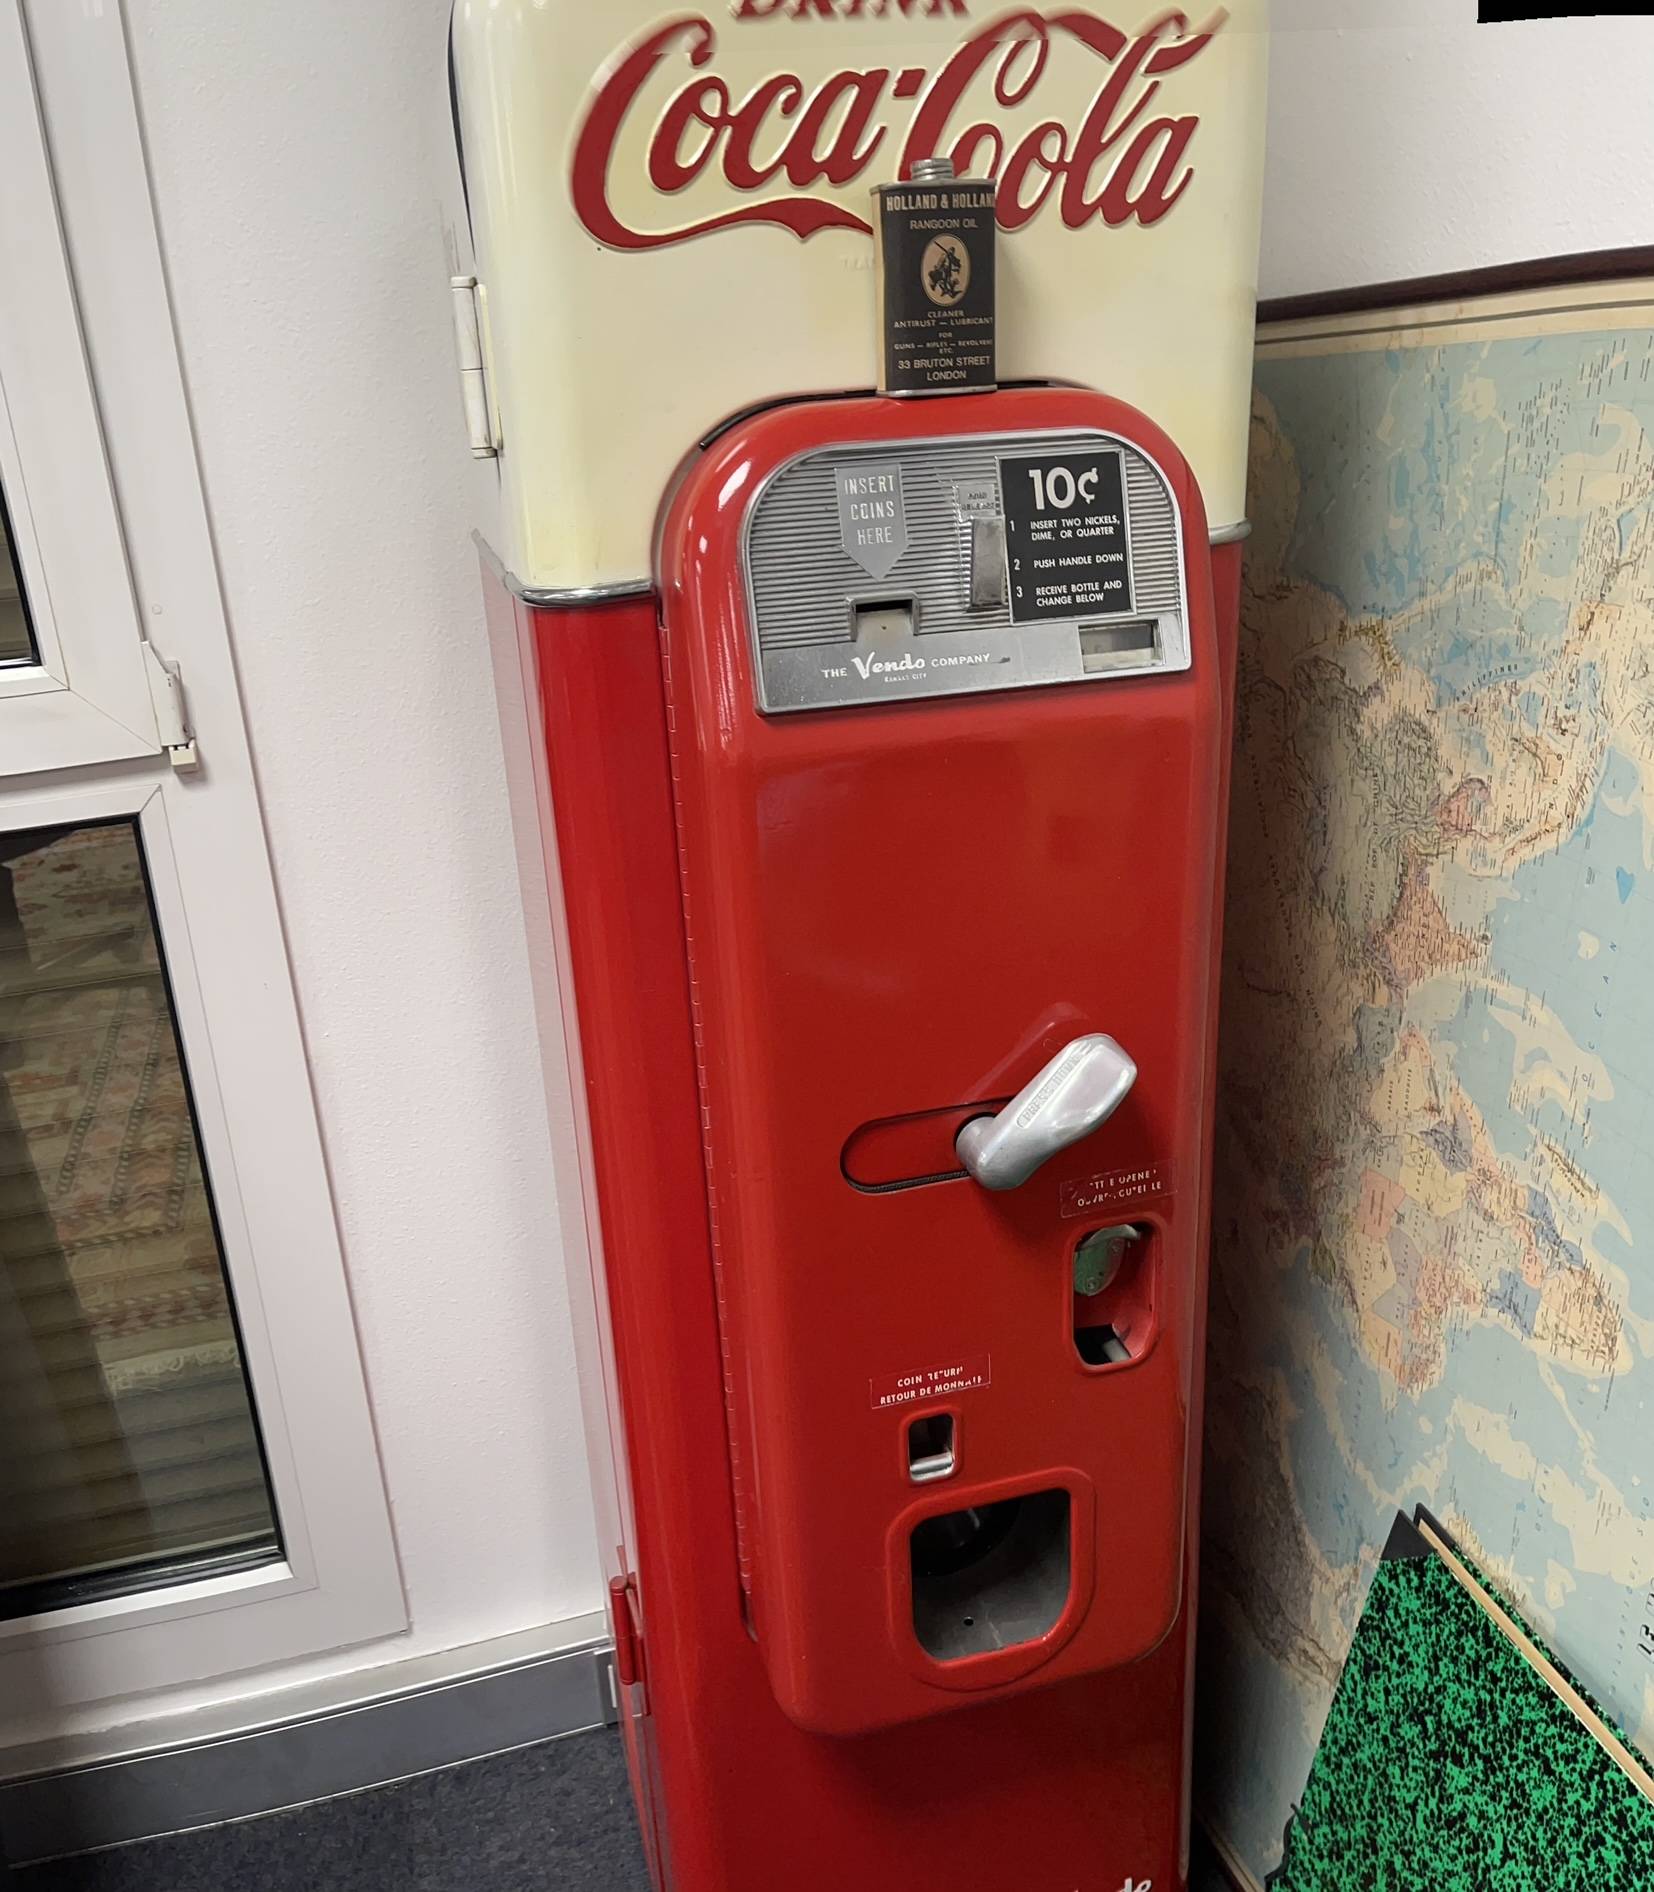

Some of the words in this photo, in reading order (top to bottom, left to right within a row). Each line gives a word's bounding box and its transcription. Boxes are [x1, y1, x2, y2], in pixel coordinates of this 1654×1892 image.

[571, 7, 1229, 250] Coca-Cola
[886, 194, 938, 211] HOLLAND
[940, 194, 949, 209] &
[910, 219, 960, 230] RANGOON
[962, 218, 978, 228] OIL
[928, 310, 964, 318] CLEANER
[894, 319, 936, 328] ANTIRUST
[898, 360, 911, 369] 33
[913, 358, 954, 369] BRUTON
[956, 355, 991, 366] STREET
[927, 370, 967, 381] LONDON
[844, 475, 895, 496] INSERT
[1028, 466, 1099, 511] 10¢
[850, 501, 895, 521] COINS
[1009, 519, 1015, 531] 1
[1030, 519, 1057, 530] INSERT
[1061, 518, 1082, 527] TWO
[1085, 514, 1120, 526] NICKELS,
[857, 526, 893, 546] HERE
[1031, 531, 1055, 541] DIME,
[1060, 529, 1073, 539] OR
[1076, 526, 1115, 538] QUARTER
[1013, 559, 1020, 571] 2
[1033, 558, 1056, 569] PUSH
[1059, 555, 1092, 567] HANDLE
[1095, 553, 1124, 564] DOWN
[1016, 585, 1023, 598] 3
[1035, 584, 1068, 596] RECEIVE
[1071, 582, 1100, 593] BOTTLE
[1103, 580, 1122, 590] AND
[1036, 595, 1072, 607] CHANGE
[1076, 592, 1104, 604] BELOW
[821, 667, 848, 679] THE
[851, 651, 926, 680] Vendo
[931, 653, 991, 668] COMPANY
[897, 1374, 923, 1388] COIN
[880, 1390, 916, 1405] RETOUR
[919, 1386, 932, 1397] DE
